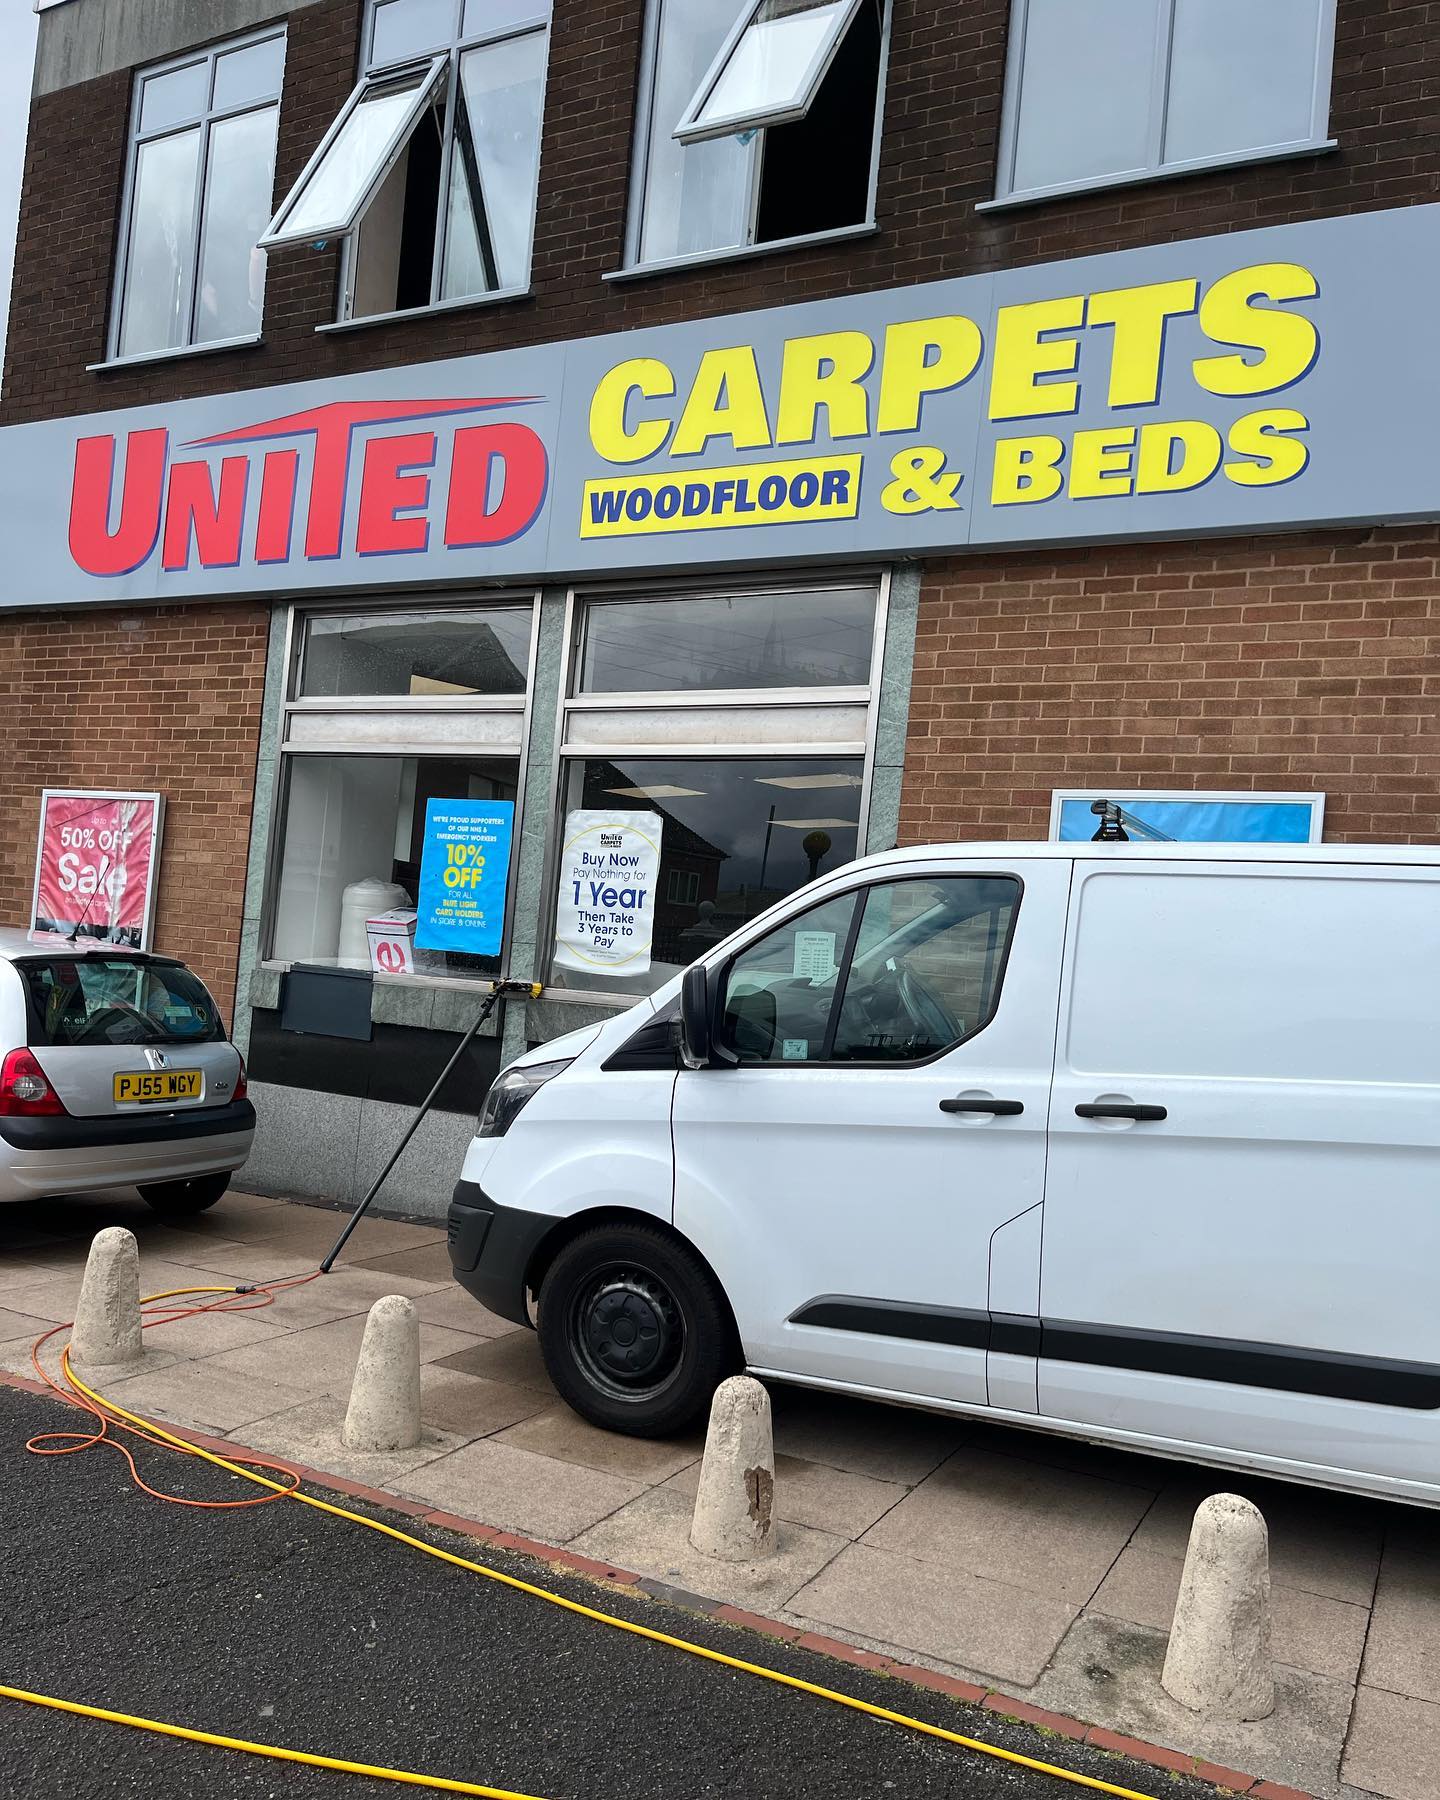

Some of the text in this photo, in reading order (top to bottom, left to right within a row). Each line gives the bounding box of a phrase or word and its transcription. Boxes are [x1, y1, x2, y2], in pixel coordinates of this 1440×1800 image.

[589, 262, 1320, 466] CARPETS
[590, 408, 1310, 524] WOODFLOOR & BEDS
[68, 396, 549, 577] UNITED
[61, 827, 134, 852] 50% OFF
[446, 844, 486, 867] 10%
[582, 852, 639, 868] Buy Now
[58, 852, 128, 896] Sale
[444, 866, 483, 888] OFF
[573, 867, 646, 882] Pay Nothing for
[448, 890, 461, 898] FOR
[572, 881, 647, 908] 1 Year
[435, 908, 453, 916] CARD
[438, 918, 456, 926] STORE
[465, 920, 487, 928] ONLINE
[578, 910, 634, 924] Then Take
[578, 922, 633, 936] 3 Years to
[594, 936, 614, 948] Pay
[120, 1074, 196, 1097] PJ55 WGY
